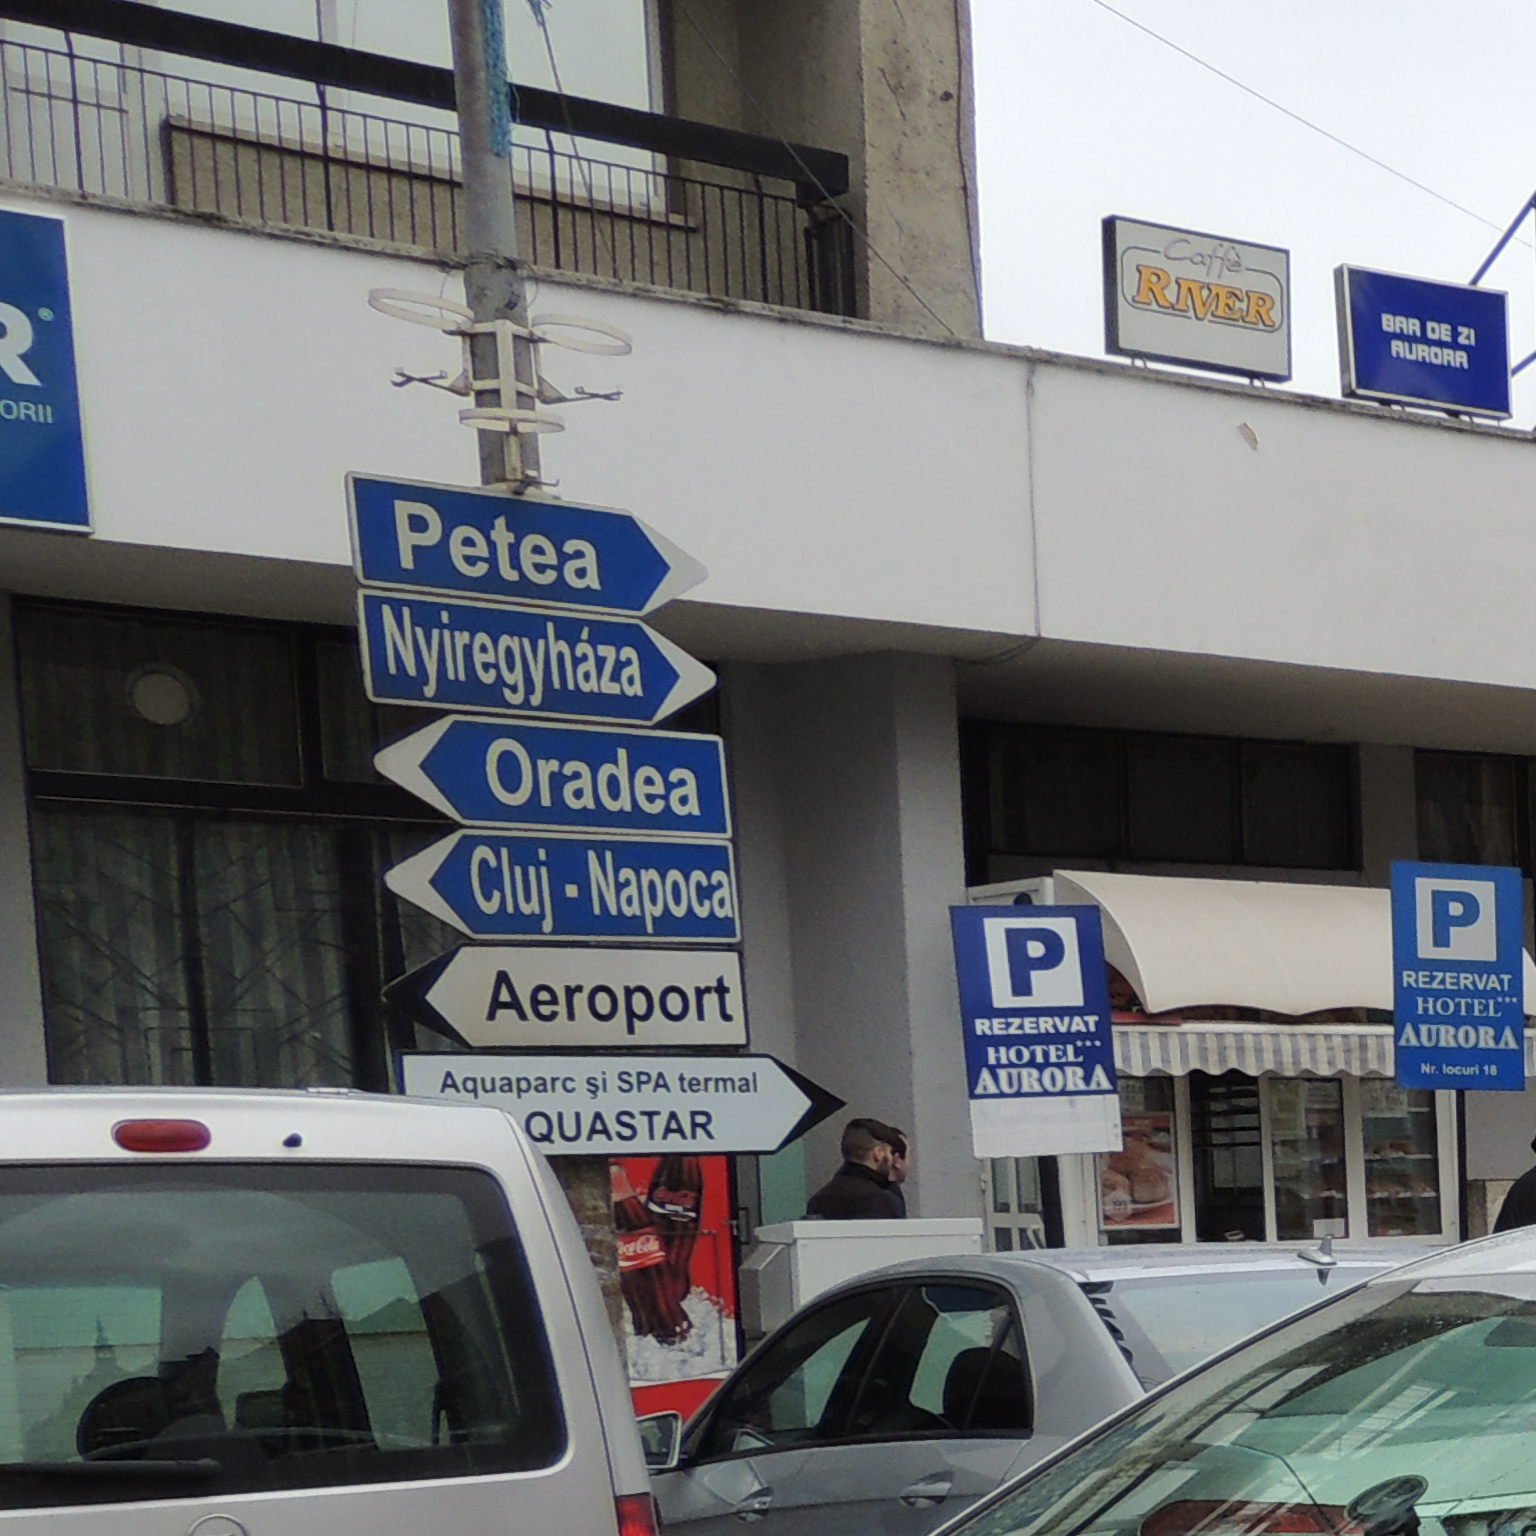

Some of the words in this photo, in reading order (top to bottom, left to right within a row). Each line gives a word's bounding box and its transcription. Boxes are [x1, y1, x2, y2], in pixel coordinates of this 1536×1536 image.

[1132, 262, 1277, 330] RIVER
[1380, 312, 1421, 338] BAR
[1425, 320, 1453, 344] DE
[1456, 325, 1477, 347] ZI
[1390, 338, 1470, 370] AURORA
[392, 498, 602, 592] Petea
[485, 738, 700, 817] Oradea
[470, 844, 553, 933] Cluj
[588, 850, 734, 934] Napoca
[1431, 888, 1481, 948] P
[1004, 927, 1066, 998] P
[1402, 970, 1513, 991] REZERVAT
[485, 969, 734, 1036] Aeroport
[1416, 996, 1503, 1017] HOTEL
[974, 1015, 1099, 1036] REZERVAT
[1398, 1022, 1520, 1050] AURORA
[986, 1044, 1084, 1065] HOTEL
[1442, 1063, 1479, 1076] locuri
[439, 1070, 577, 1100] Aquaparc
[617, 1070, 672, 1095] SPA
[677, 1071, 759, 1095] termal
[973, 1063, 1114, 1095] AURORA
[524, 1110, 716, 1144] QUASTAR
